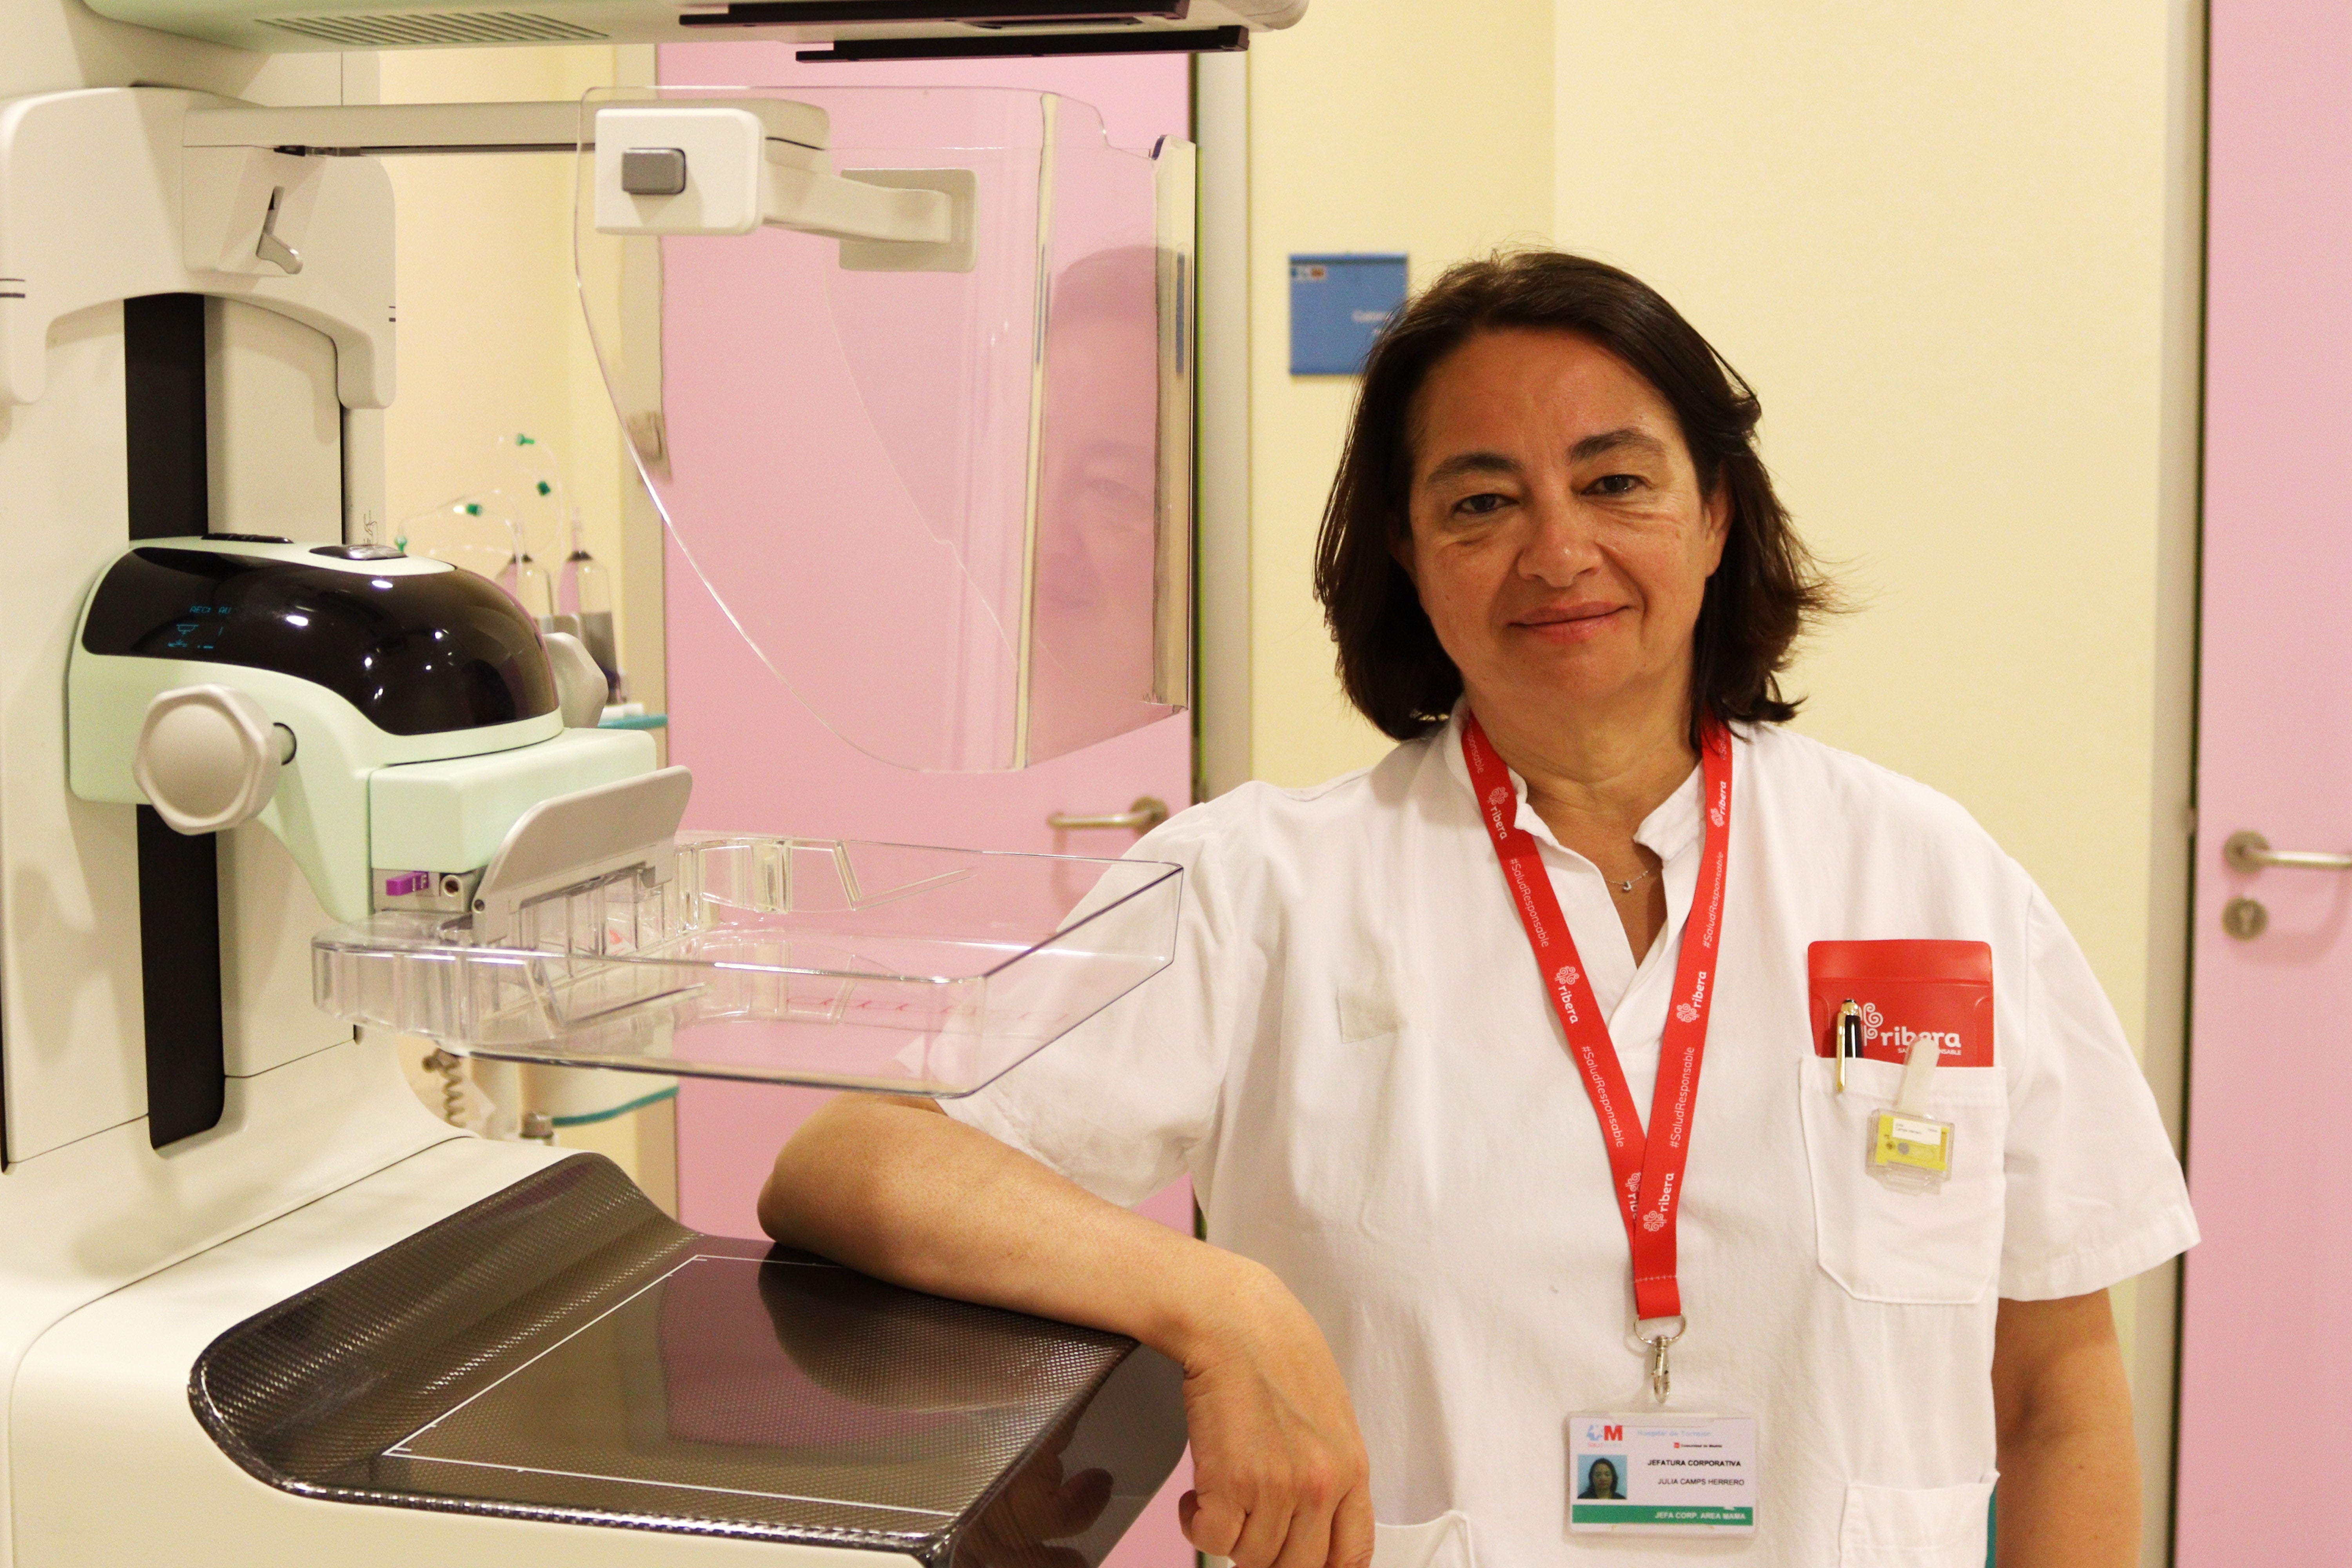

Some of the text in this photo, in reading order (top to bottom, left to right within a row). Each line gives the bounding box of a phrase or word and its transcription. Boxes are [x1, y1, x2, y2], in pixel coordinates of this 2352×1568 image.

[1491, 806, 1507, 840] ribera
[1510, 858, 1549, 947] #SaludResponsable
[1703, 852, 1723, 948] #SaludResponsable
[1559, 985, 1578, 1024] ribera
[1692, 971, 1707, 1008] ribera
[1582, 1046, 1624, 1148] #SaludResponsable
[1670, 1047, 1695, 1148] #SaludResponsable
[1658, 1173, 1675, 1212] ribera
